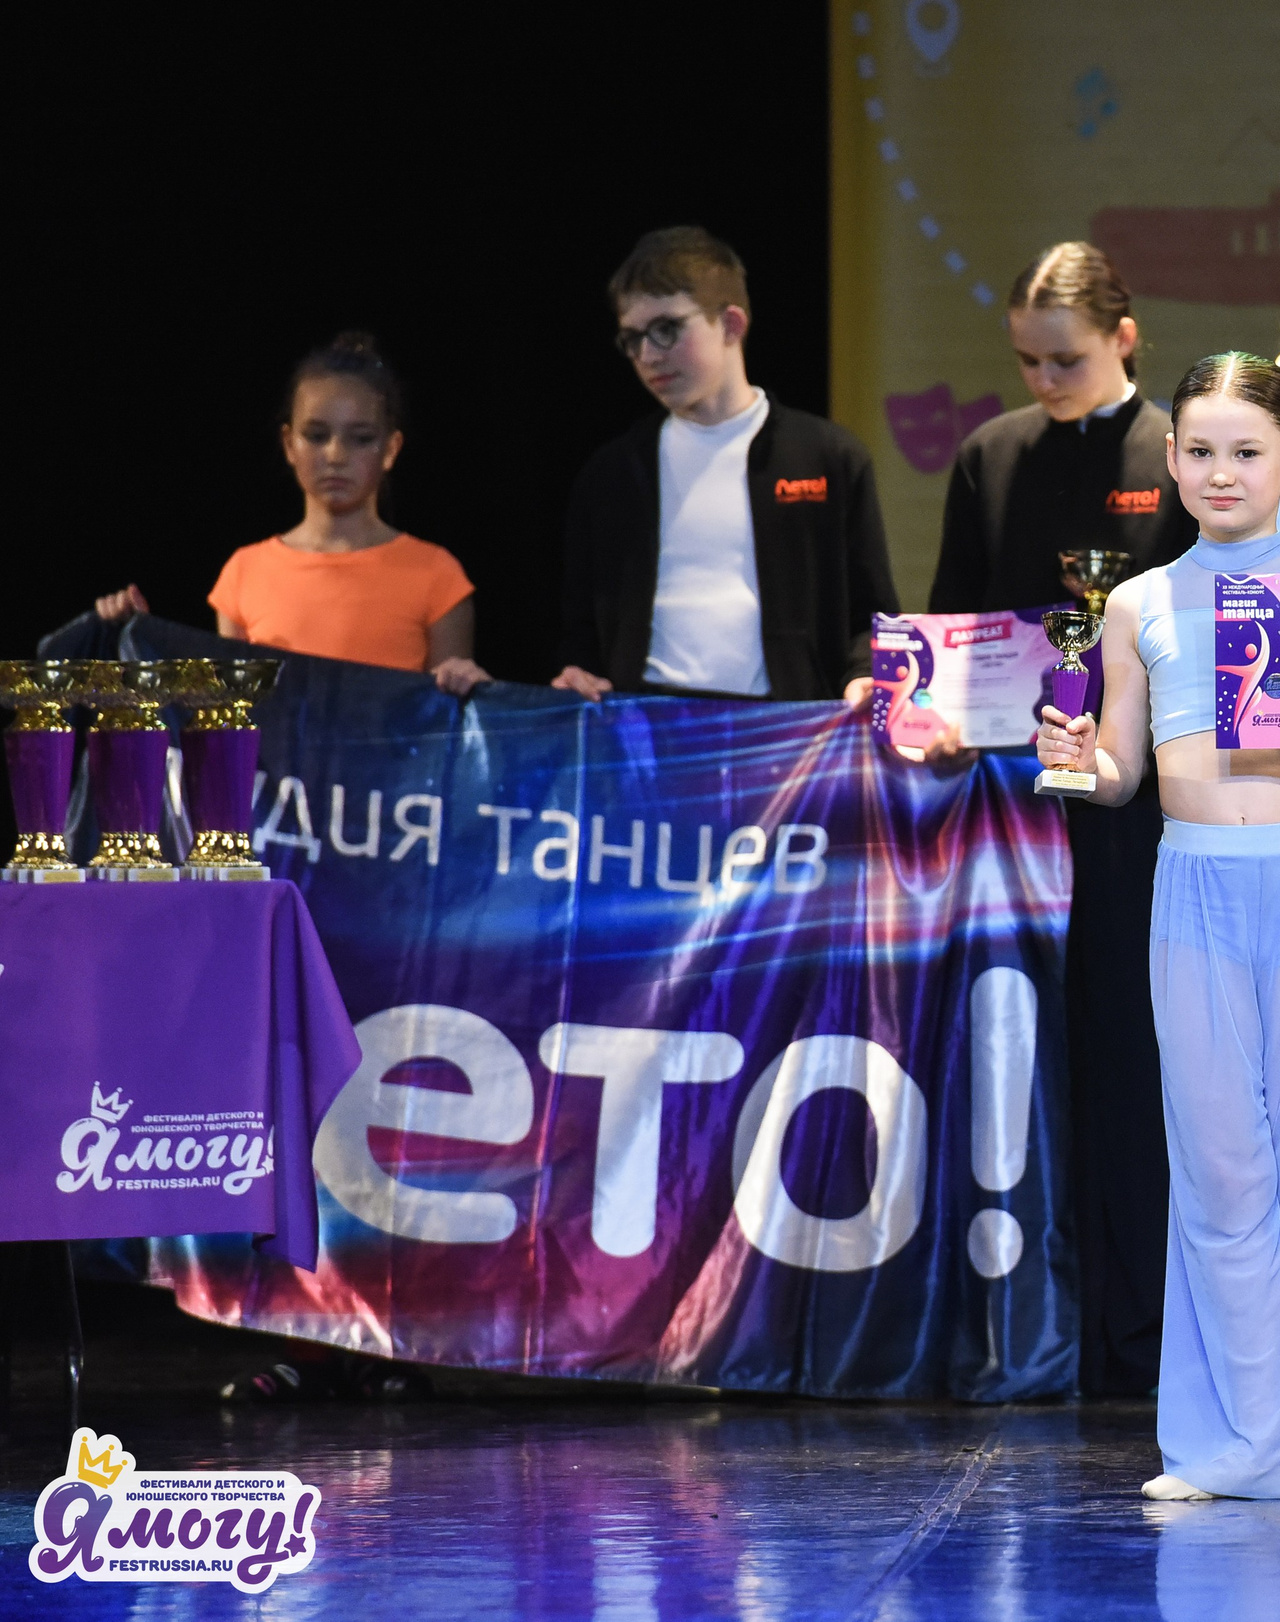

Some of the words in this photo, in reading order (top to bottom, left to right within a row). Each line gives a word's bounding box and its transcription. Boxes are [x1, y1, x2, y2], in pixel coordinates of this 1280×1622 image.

[1222, 599, 1258, 608] магия
[1222, 608, 1275, 621] танца
[252, 770, 442, 866] дия
[477, 803, 828, 905] танцев
[143, 1113, 205, 1123] ФЕСТИВАЛИ
[206, 1112, 256, 1122] ДЕТСКОГО
[256, 1111, 264, 1120] И
[313, 966, 1038, 1280] ето!
[131, 1124, 202, 1133] ЮНОШЕСКОГО
[203, 1121, 264, 1131] ТВОРЧЕСТВА
[56, 1117, 121, 1193] Я
[116, 1175, 221, 1190] FESTRUSSIA.RU
